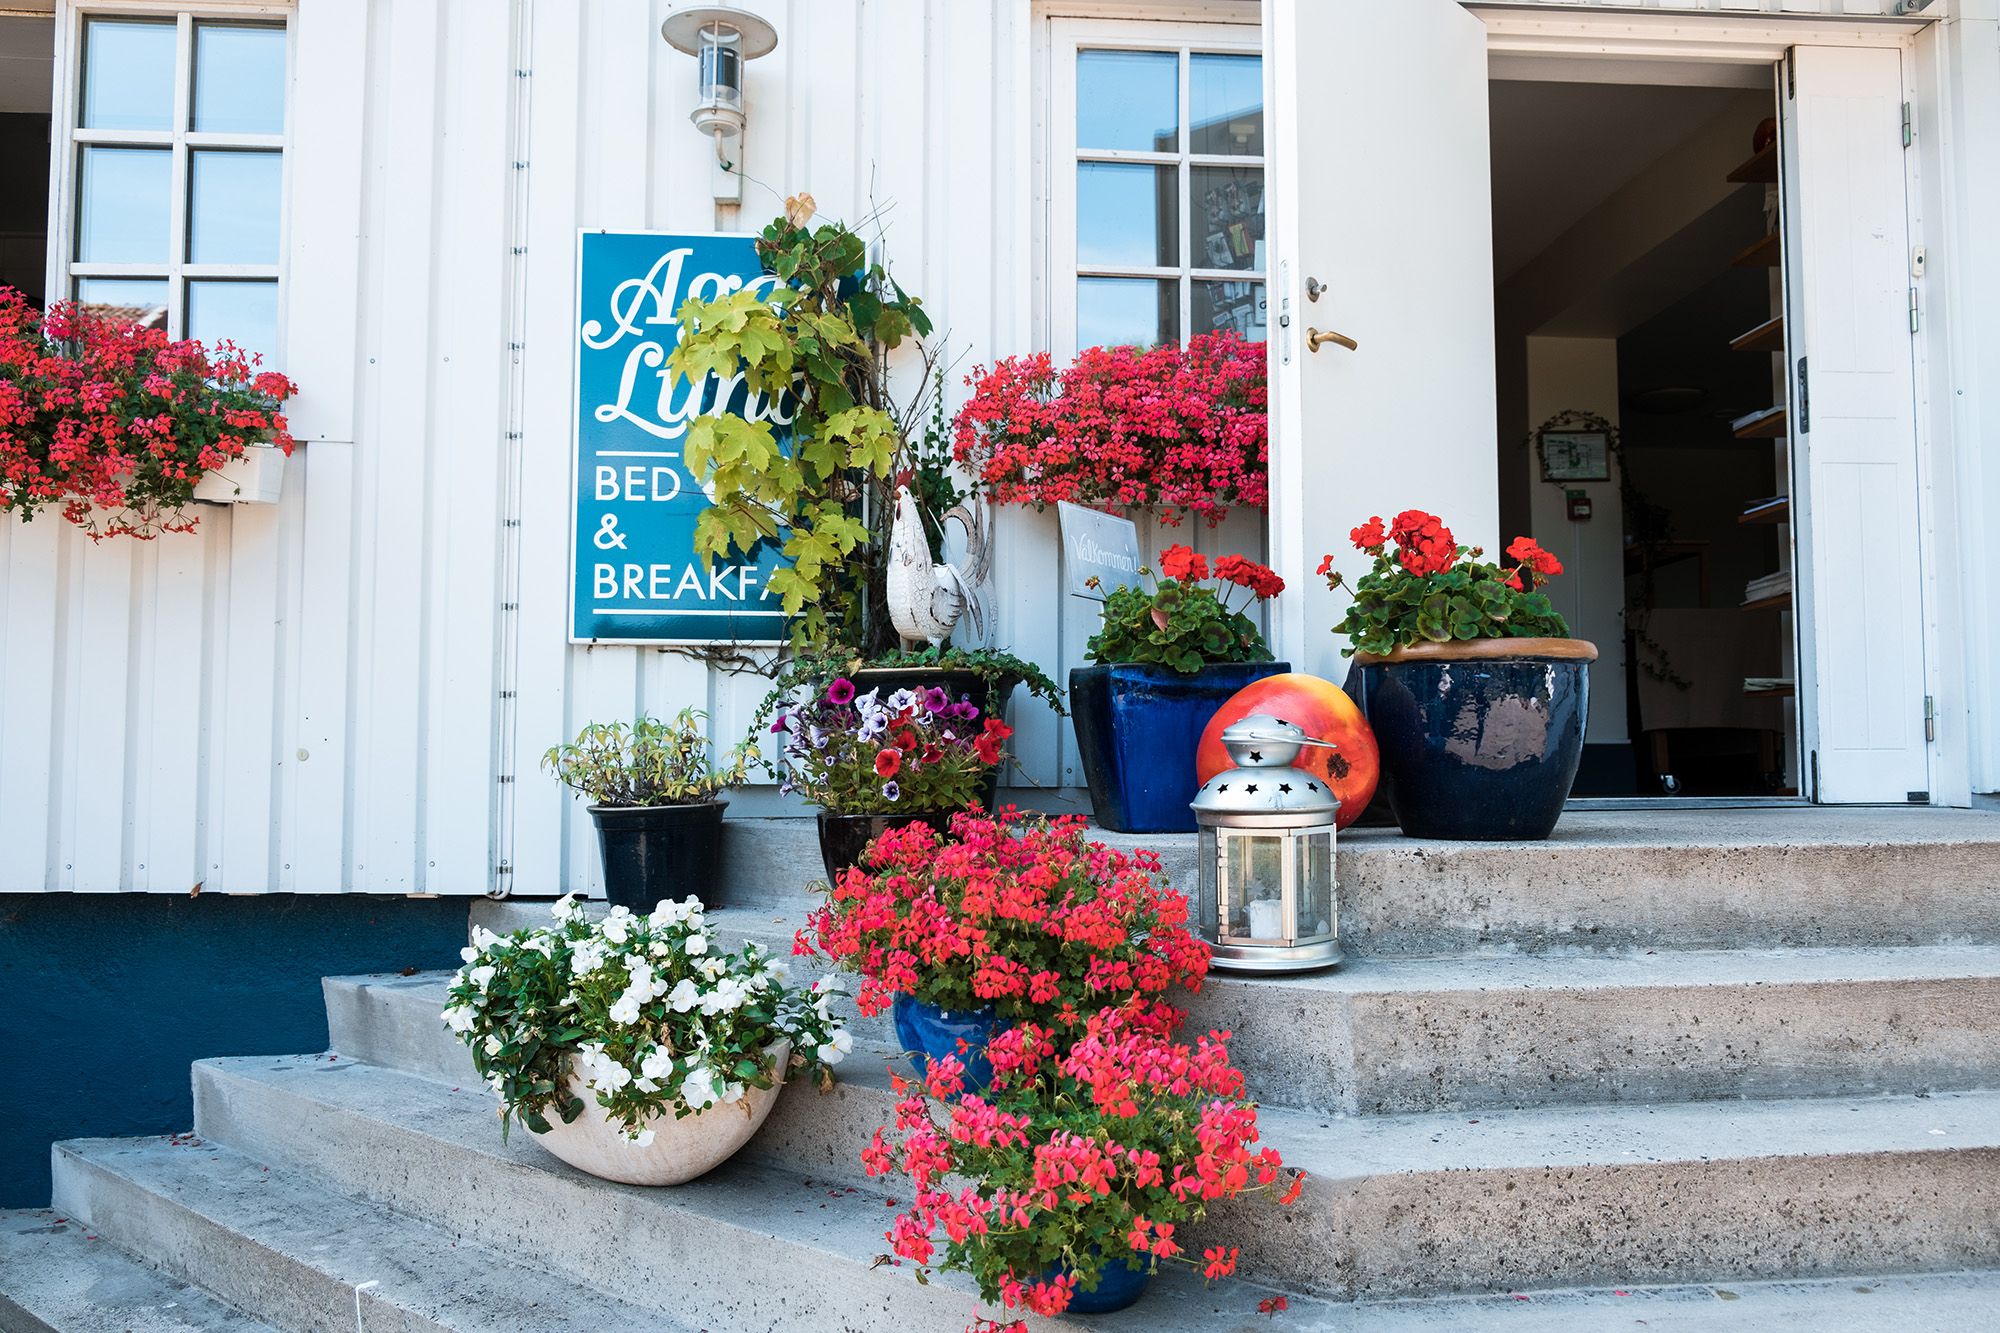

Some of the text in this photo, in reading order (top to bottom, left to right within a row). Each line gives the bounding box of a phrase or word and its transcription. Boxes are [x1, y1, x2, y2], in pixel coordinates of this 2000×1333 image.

[595, 466, 681, 501] BED
[593, 513, 628, 550] &
[593, 562, 845, 601] BREAKF
